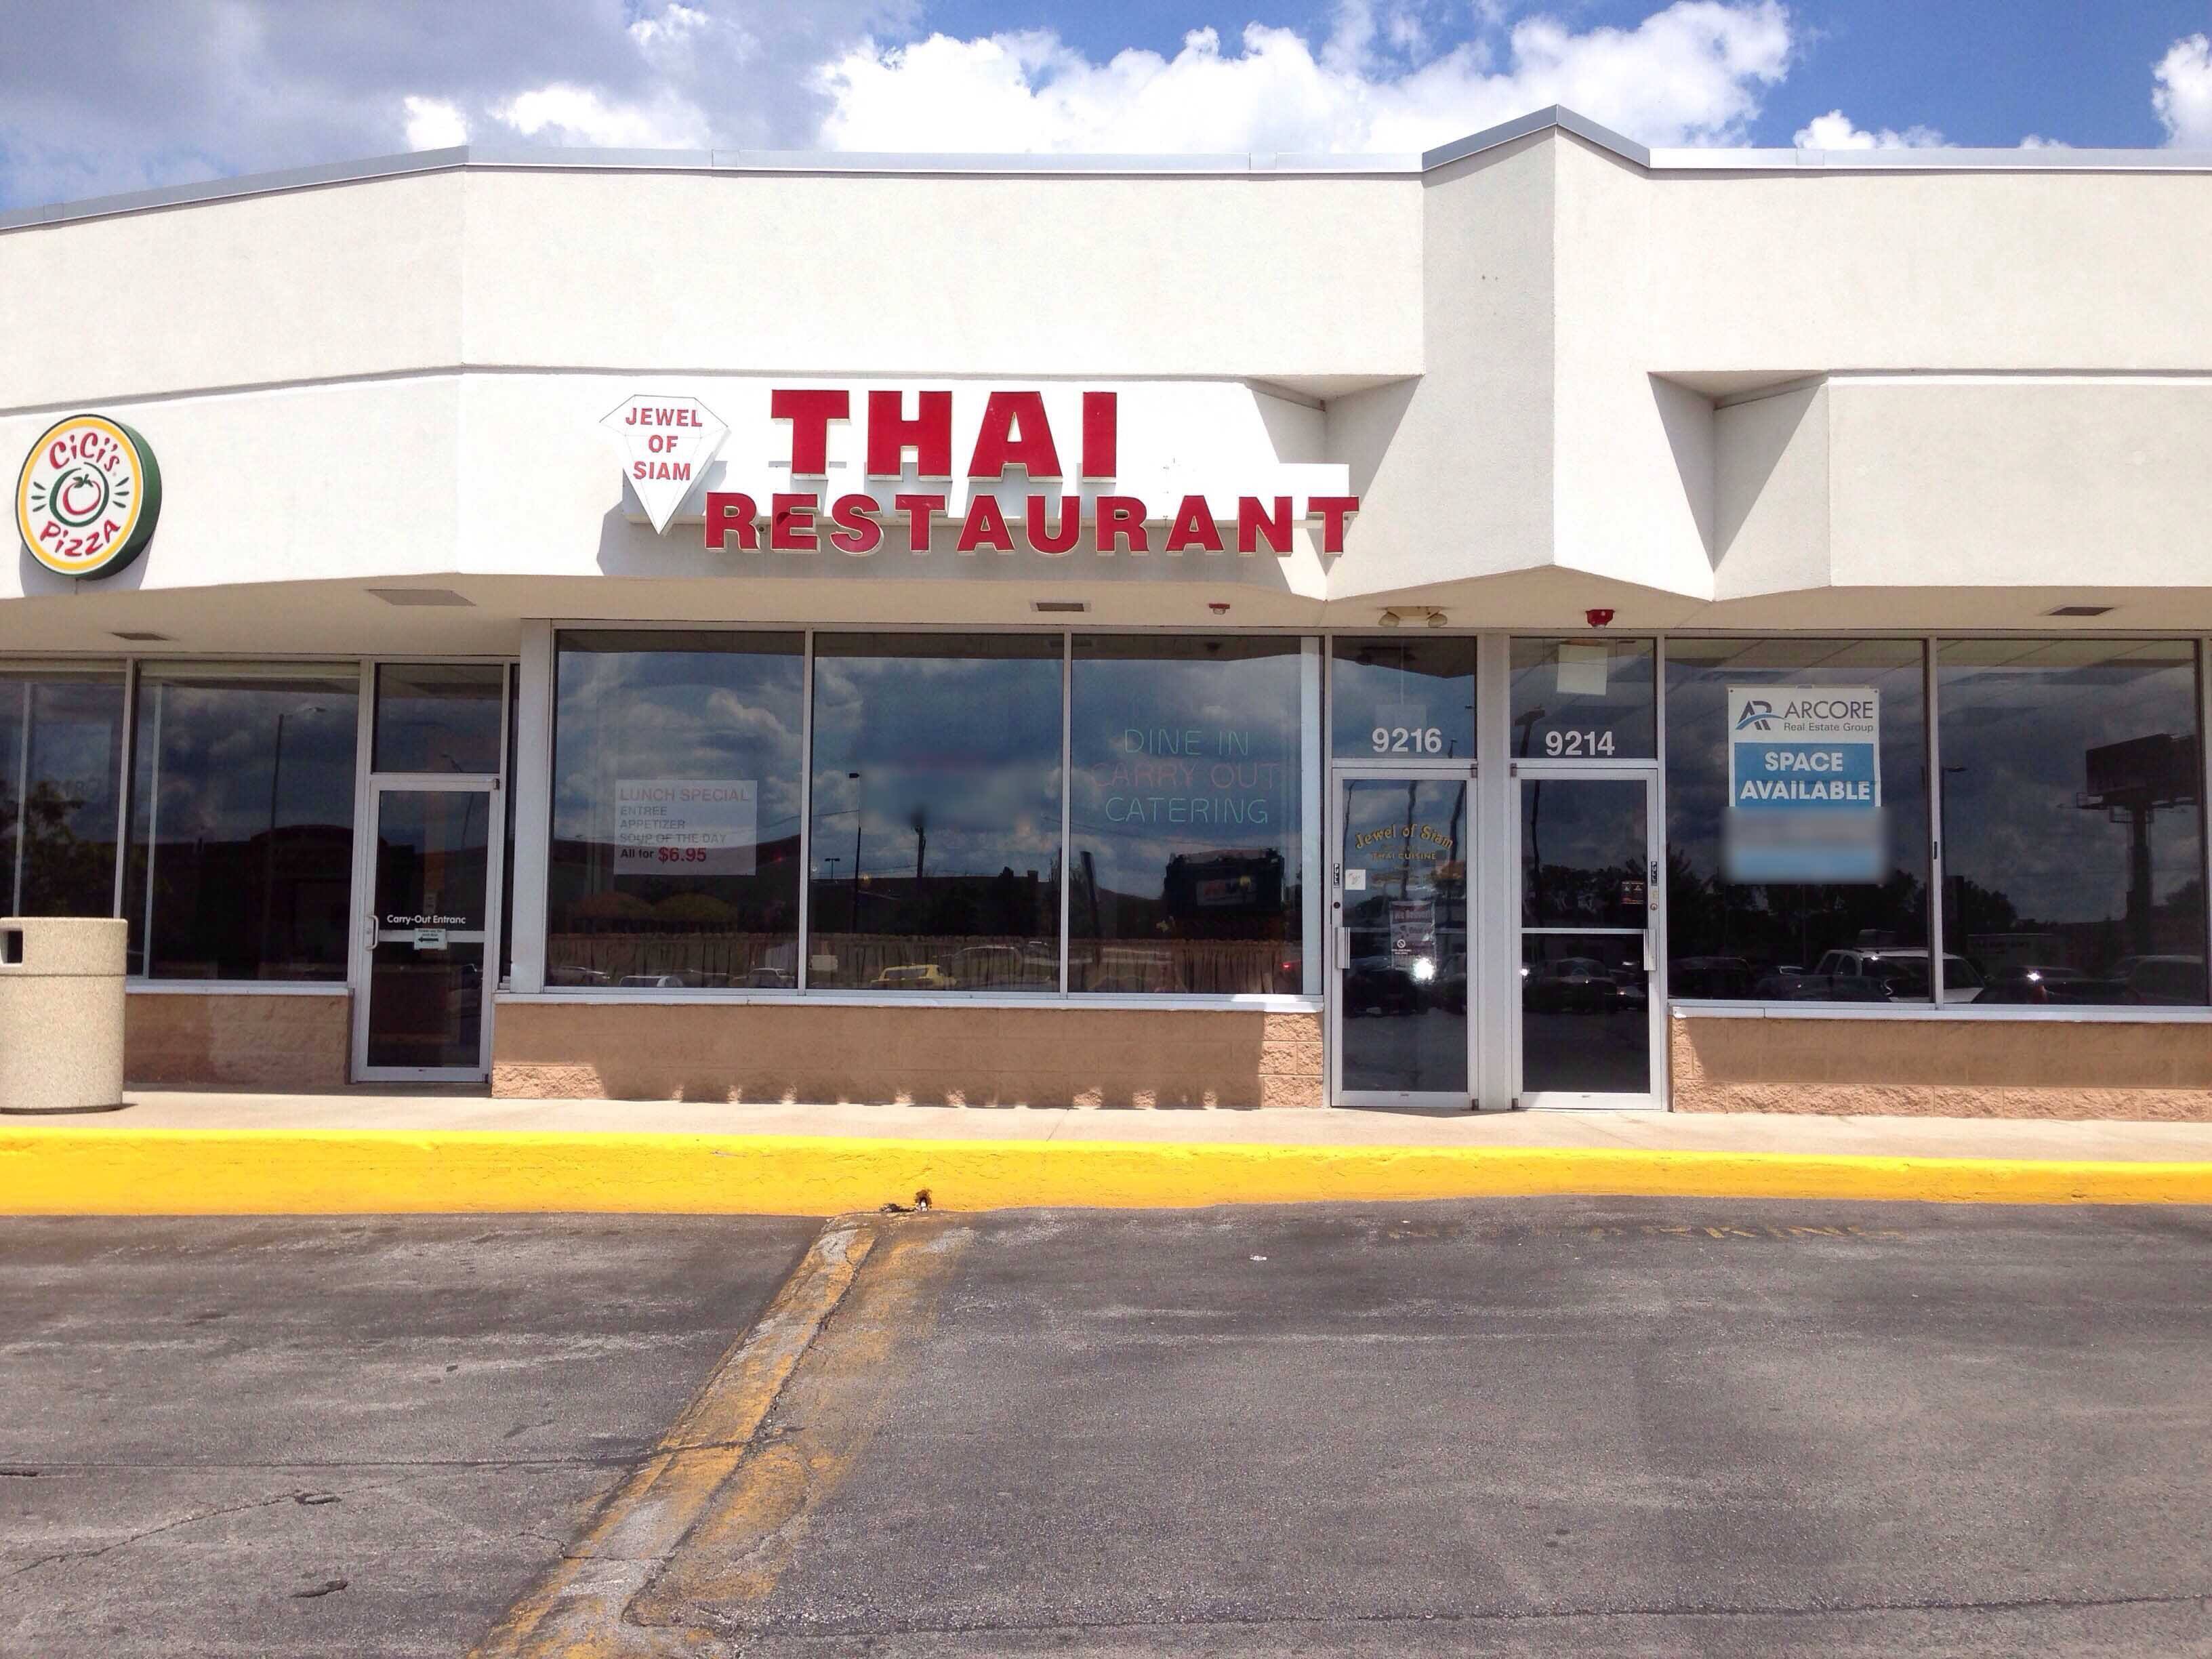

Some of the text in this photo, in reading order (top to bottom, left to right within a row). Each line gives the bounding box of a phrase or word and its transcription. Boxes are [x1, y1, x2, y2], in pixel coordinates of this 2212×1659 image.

[625, 407, 703, 427] JEWEL
[648, 434, 678, 453] OF
[772, 390, 1118, 481] THAI
[633, 461, 691, 481] SIAM
[705, 492, 1359, 556] RESTAURANT
[1784, 701, 1874, 719] ARCORE
[1784, 722, 1874, 733] Real Estate Group
[1124, 729, 1248, 756] DINE IN
[1372, 727, 1442, 754] 9216
[1545, 731, 1615, 756] 9214
[1765, 752, 1843, 772] SPACE
[1090, 762, 1280, 790] CARRY OUT
[619, 788, 749, 801] LUNCH SPECIAL
[1740, 780, 1870, 800] AVAILABLE
[619, 806, 668, 816] ENTREE
[1105, 797, 1268, 824] CATERING
[619, 820, 686, 830] APPETIZER
[619, 834, 727, 844] SOUP OF THE DAY
[1355, 823, 1454, 849] Jewel of Siam
[620, 846, 707, 864] All for $6.95
[387, 915, 466, 925] Carry-Out Entranc
